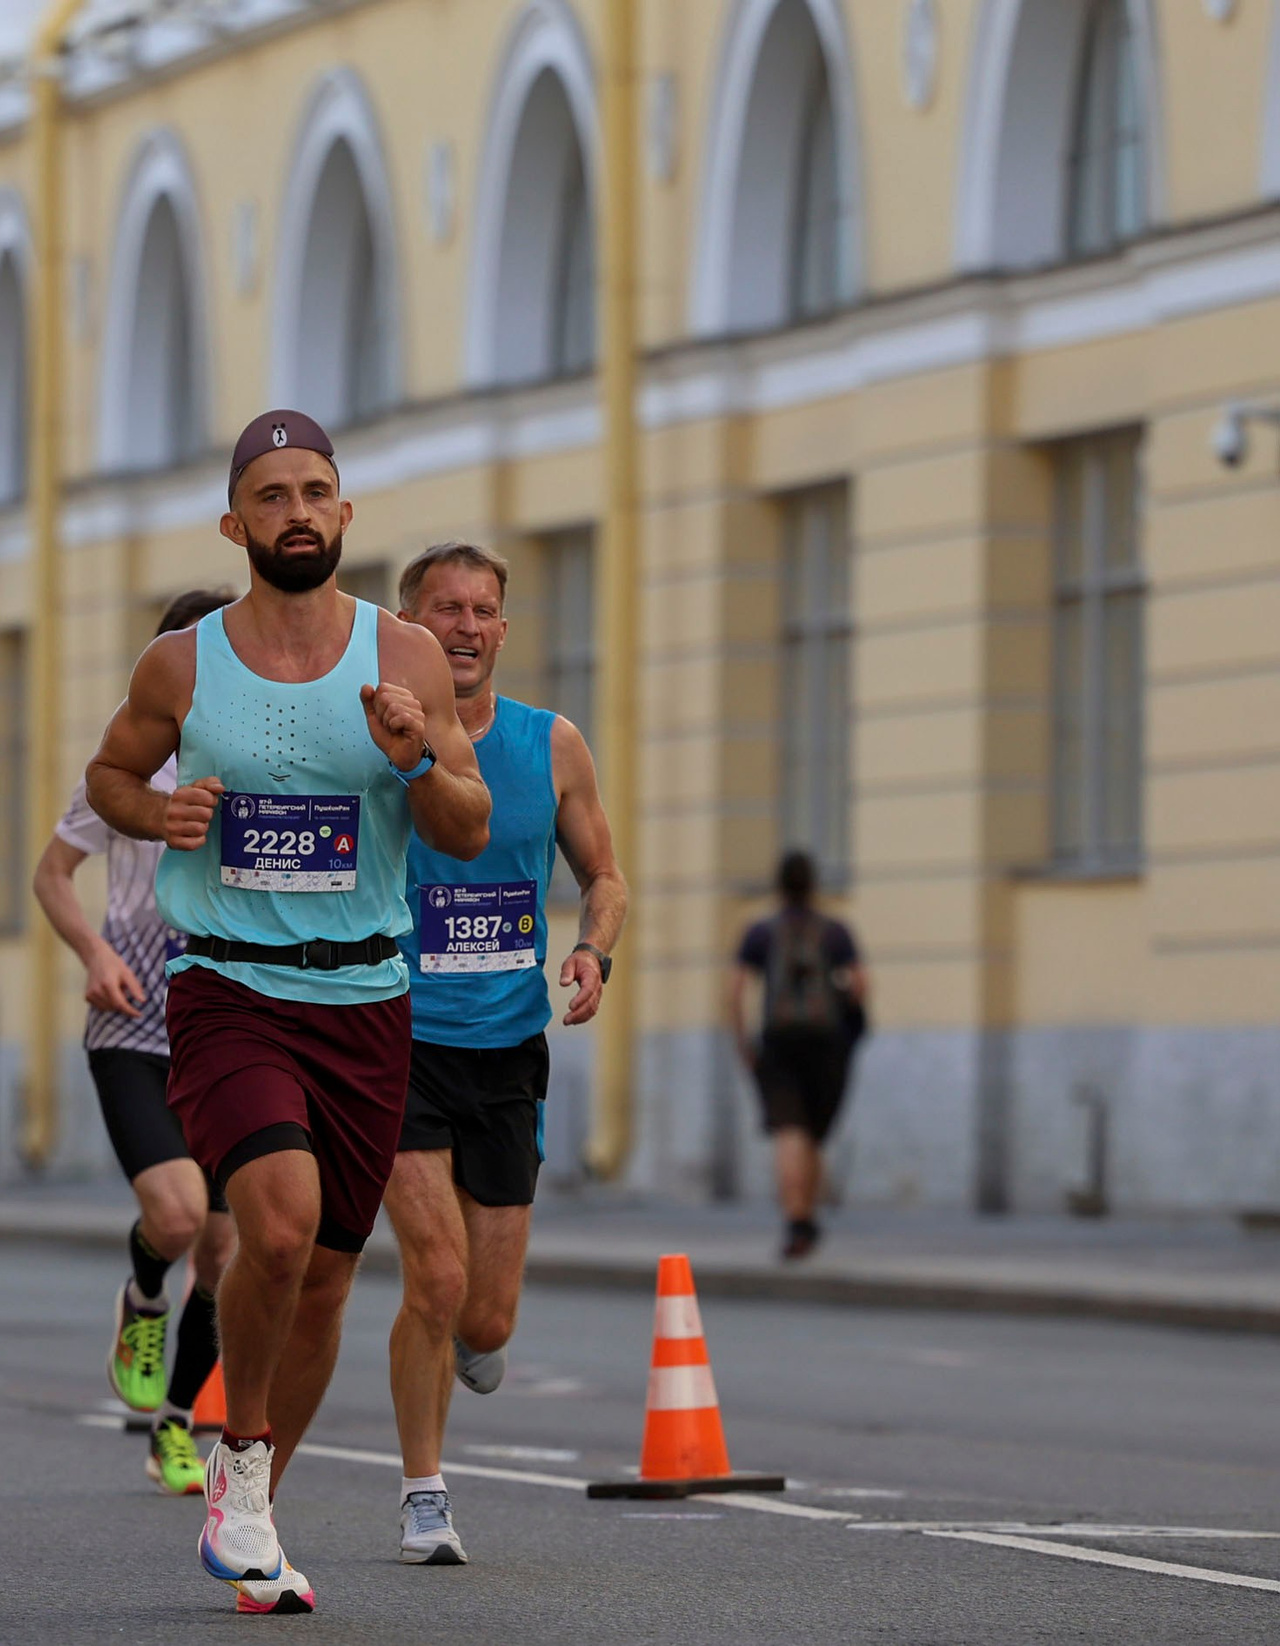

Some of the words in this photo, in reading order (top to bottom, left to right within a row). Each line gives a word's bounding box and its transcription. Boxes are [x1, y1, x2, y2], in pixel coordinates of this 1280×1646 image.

[243, 829, 316, 855] 2228
[254, 857, 302, 870] ДЕНИС
[444, 915, 503, 939] 1387
[446, 939, 500, 952] АЛЕКСЕЙ
